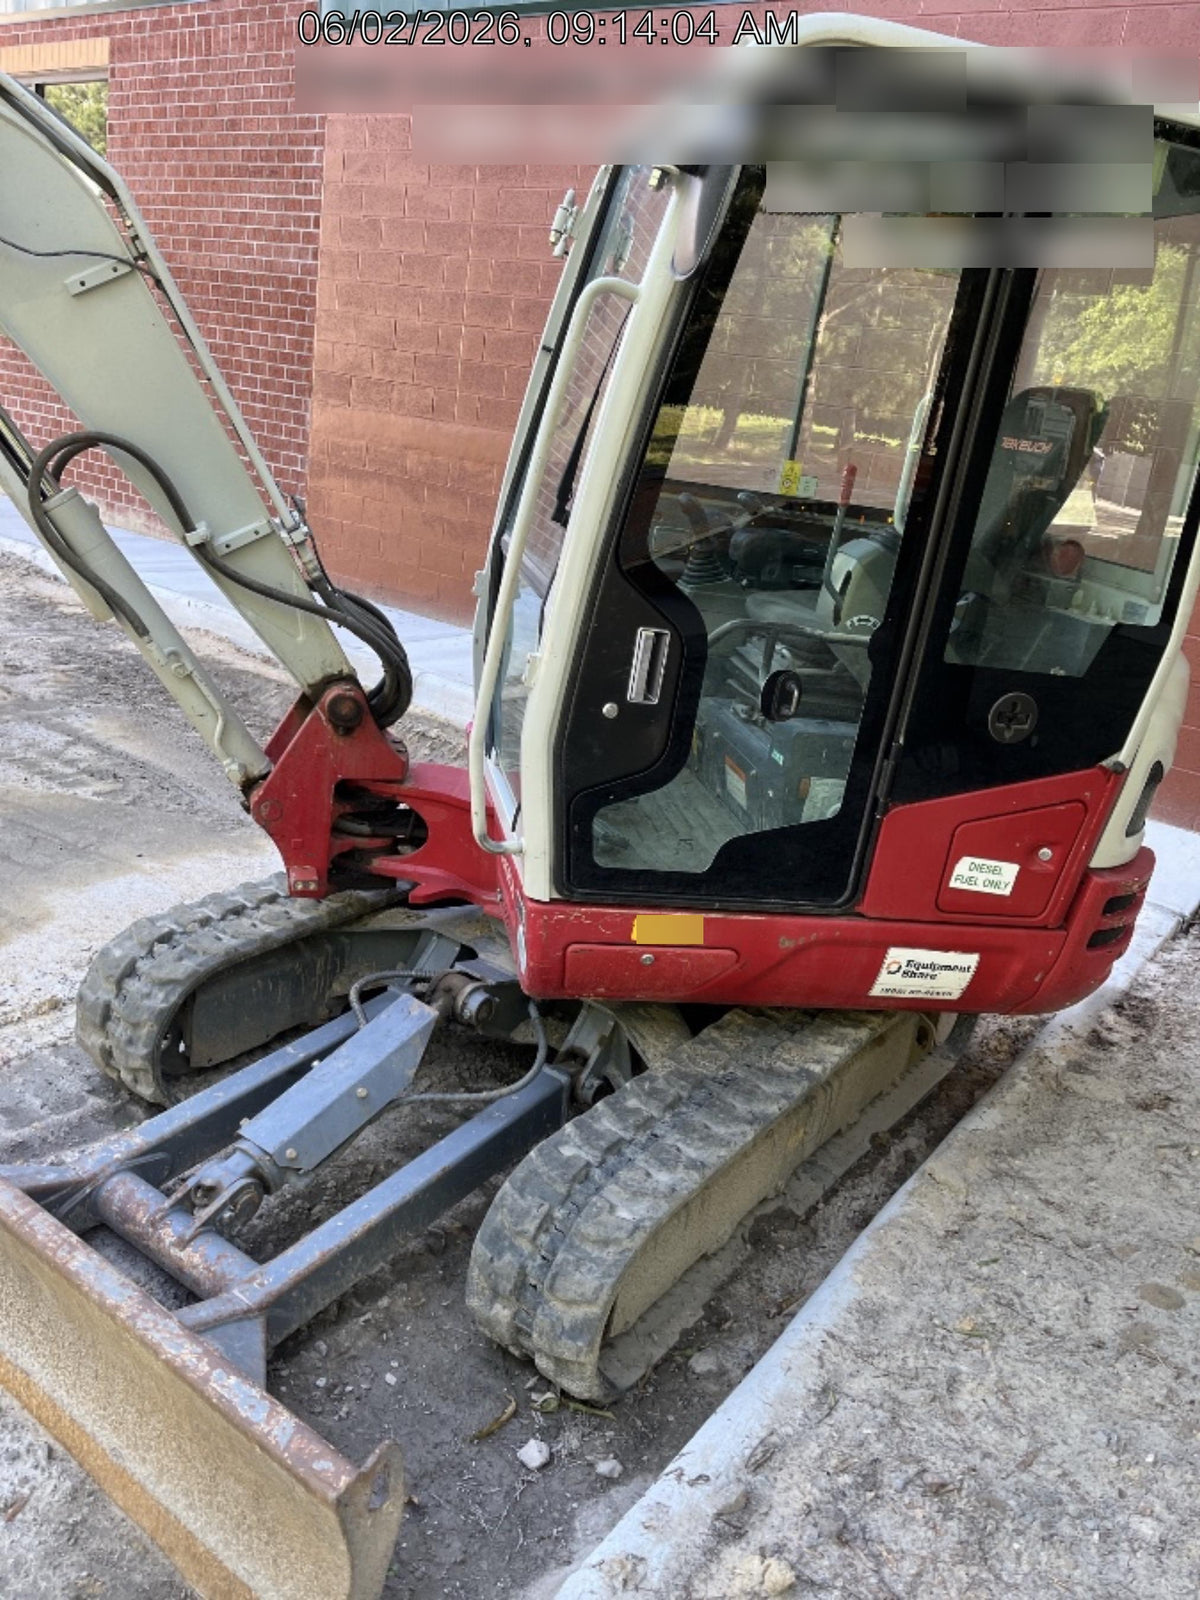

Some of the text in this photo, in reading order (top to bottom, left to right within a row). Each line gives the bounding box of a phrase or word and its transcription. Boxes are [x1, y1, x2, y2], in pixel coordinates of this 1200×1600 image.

[968, 861, 1002, 875] DIESEL
[954, 874, 1010, 890] FUEL ONLY
[904, 959, 972, 974] Equipment
[901, 969, 937, 980] Share
